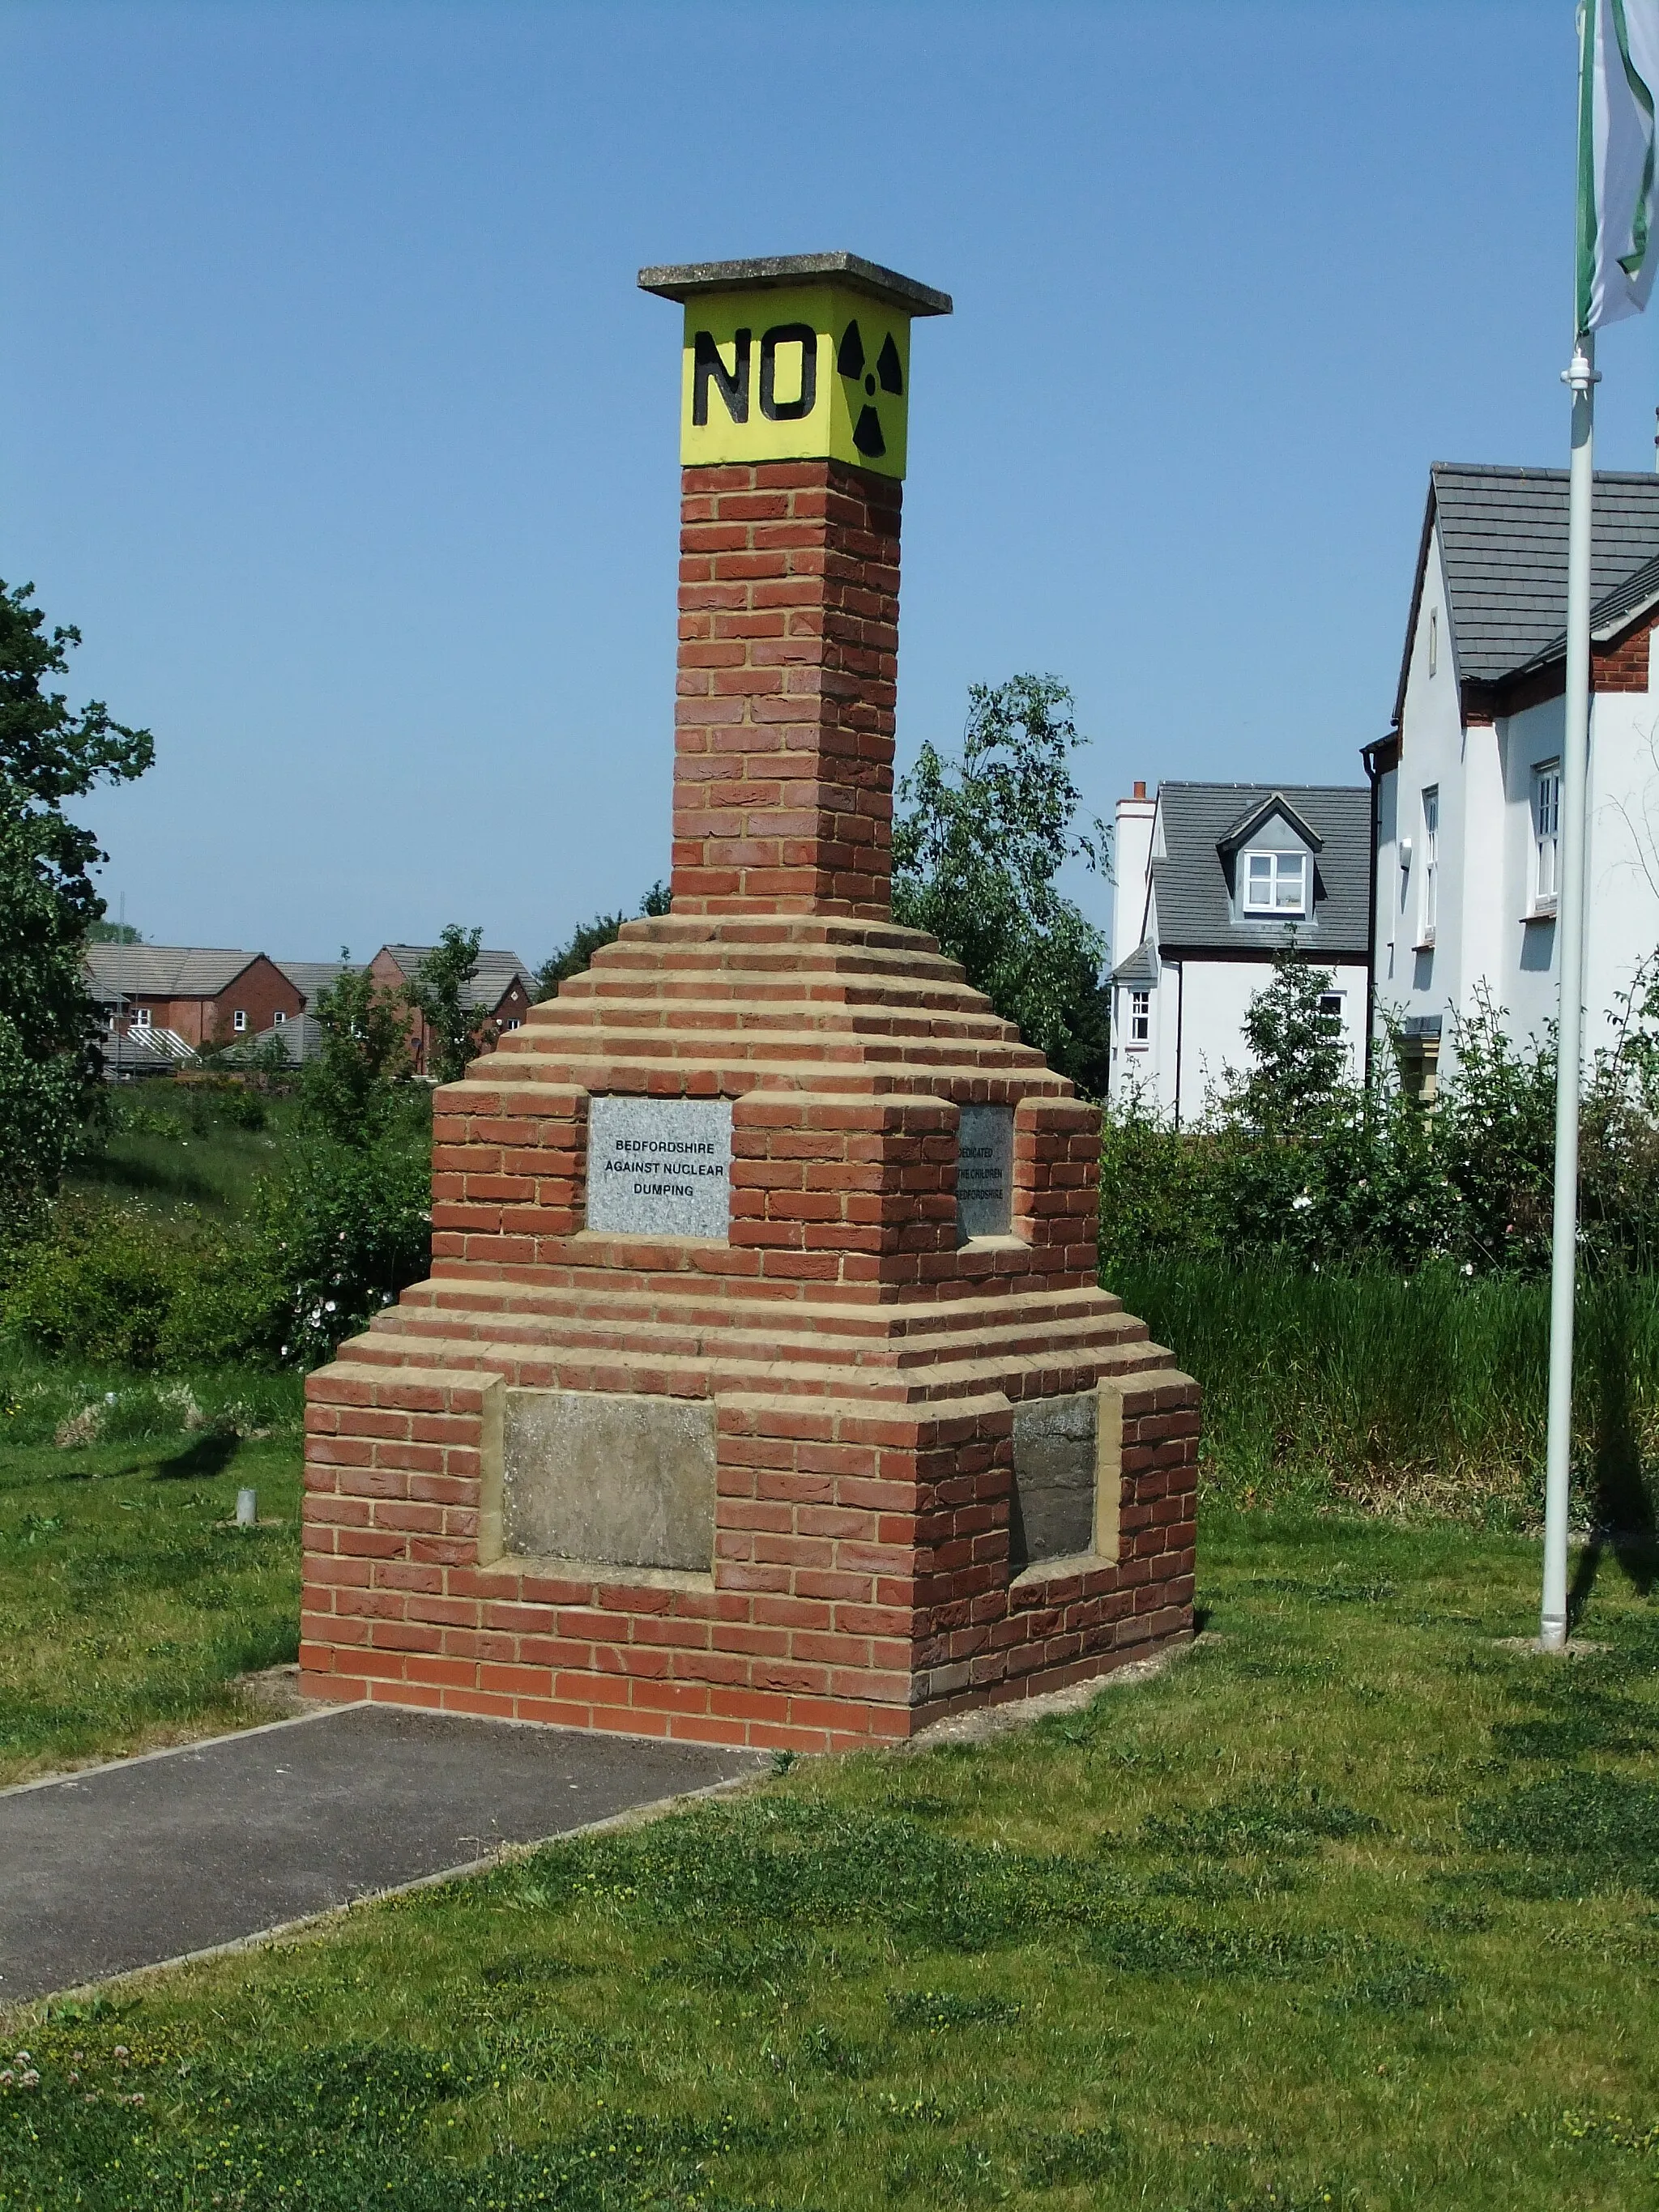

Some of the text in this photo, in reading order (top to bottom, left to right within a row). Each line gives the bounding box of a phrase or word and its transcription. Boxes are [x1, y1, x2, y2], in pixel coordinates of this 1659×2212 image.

[693, 322, 817, 426] NO
[616, 1140, 714, 1154] BEDFORDSHIRE
[605, 1161, 723, 1175] AGAINST NUCLEAR
[970, 1168, 1003, 1178] CHILDREN
[633, 1183, 693, 1196] DUMPING
